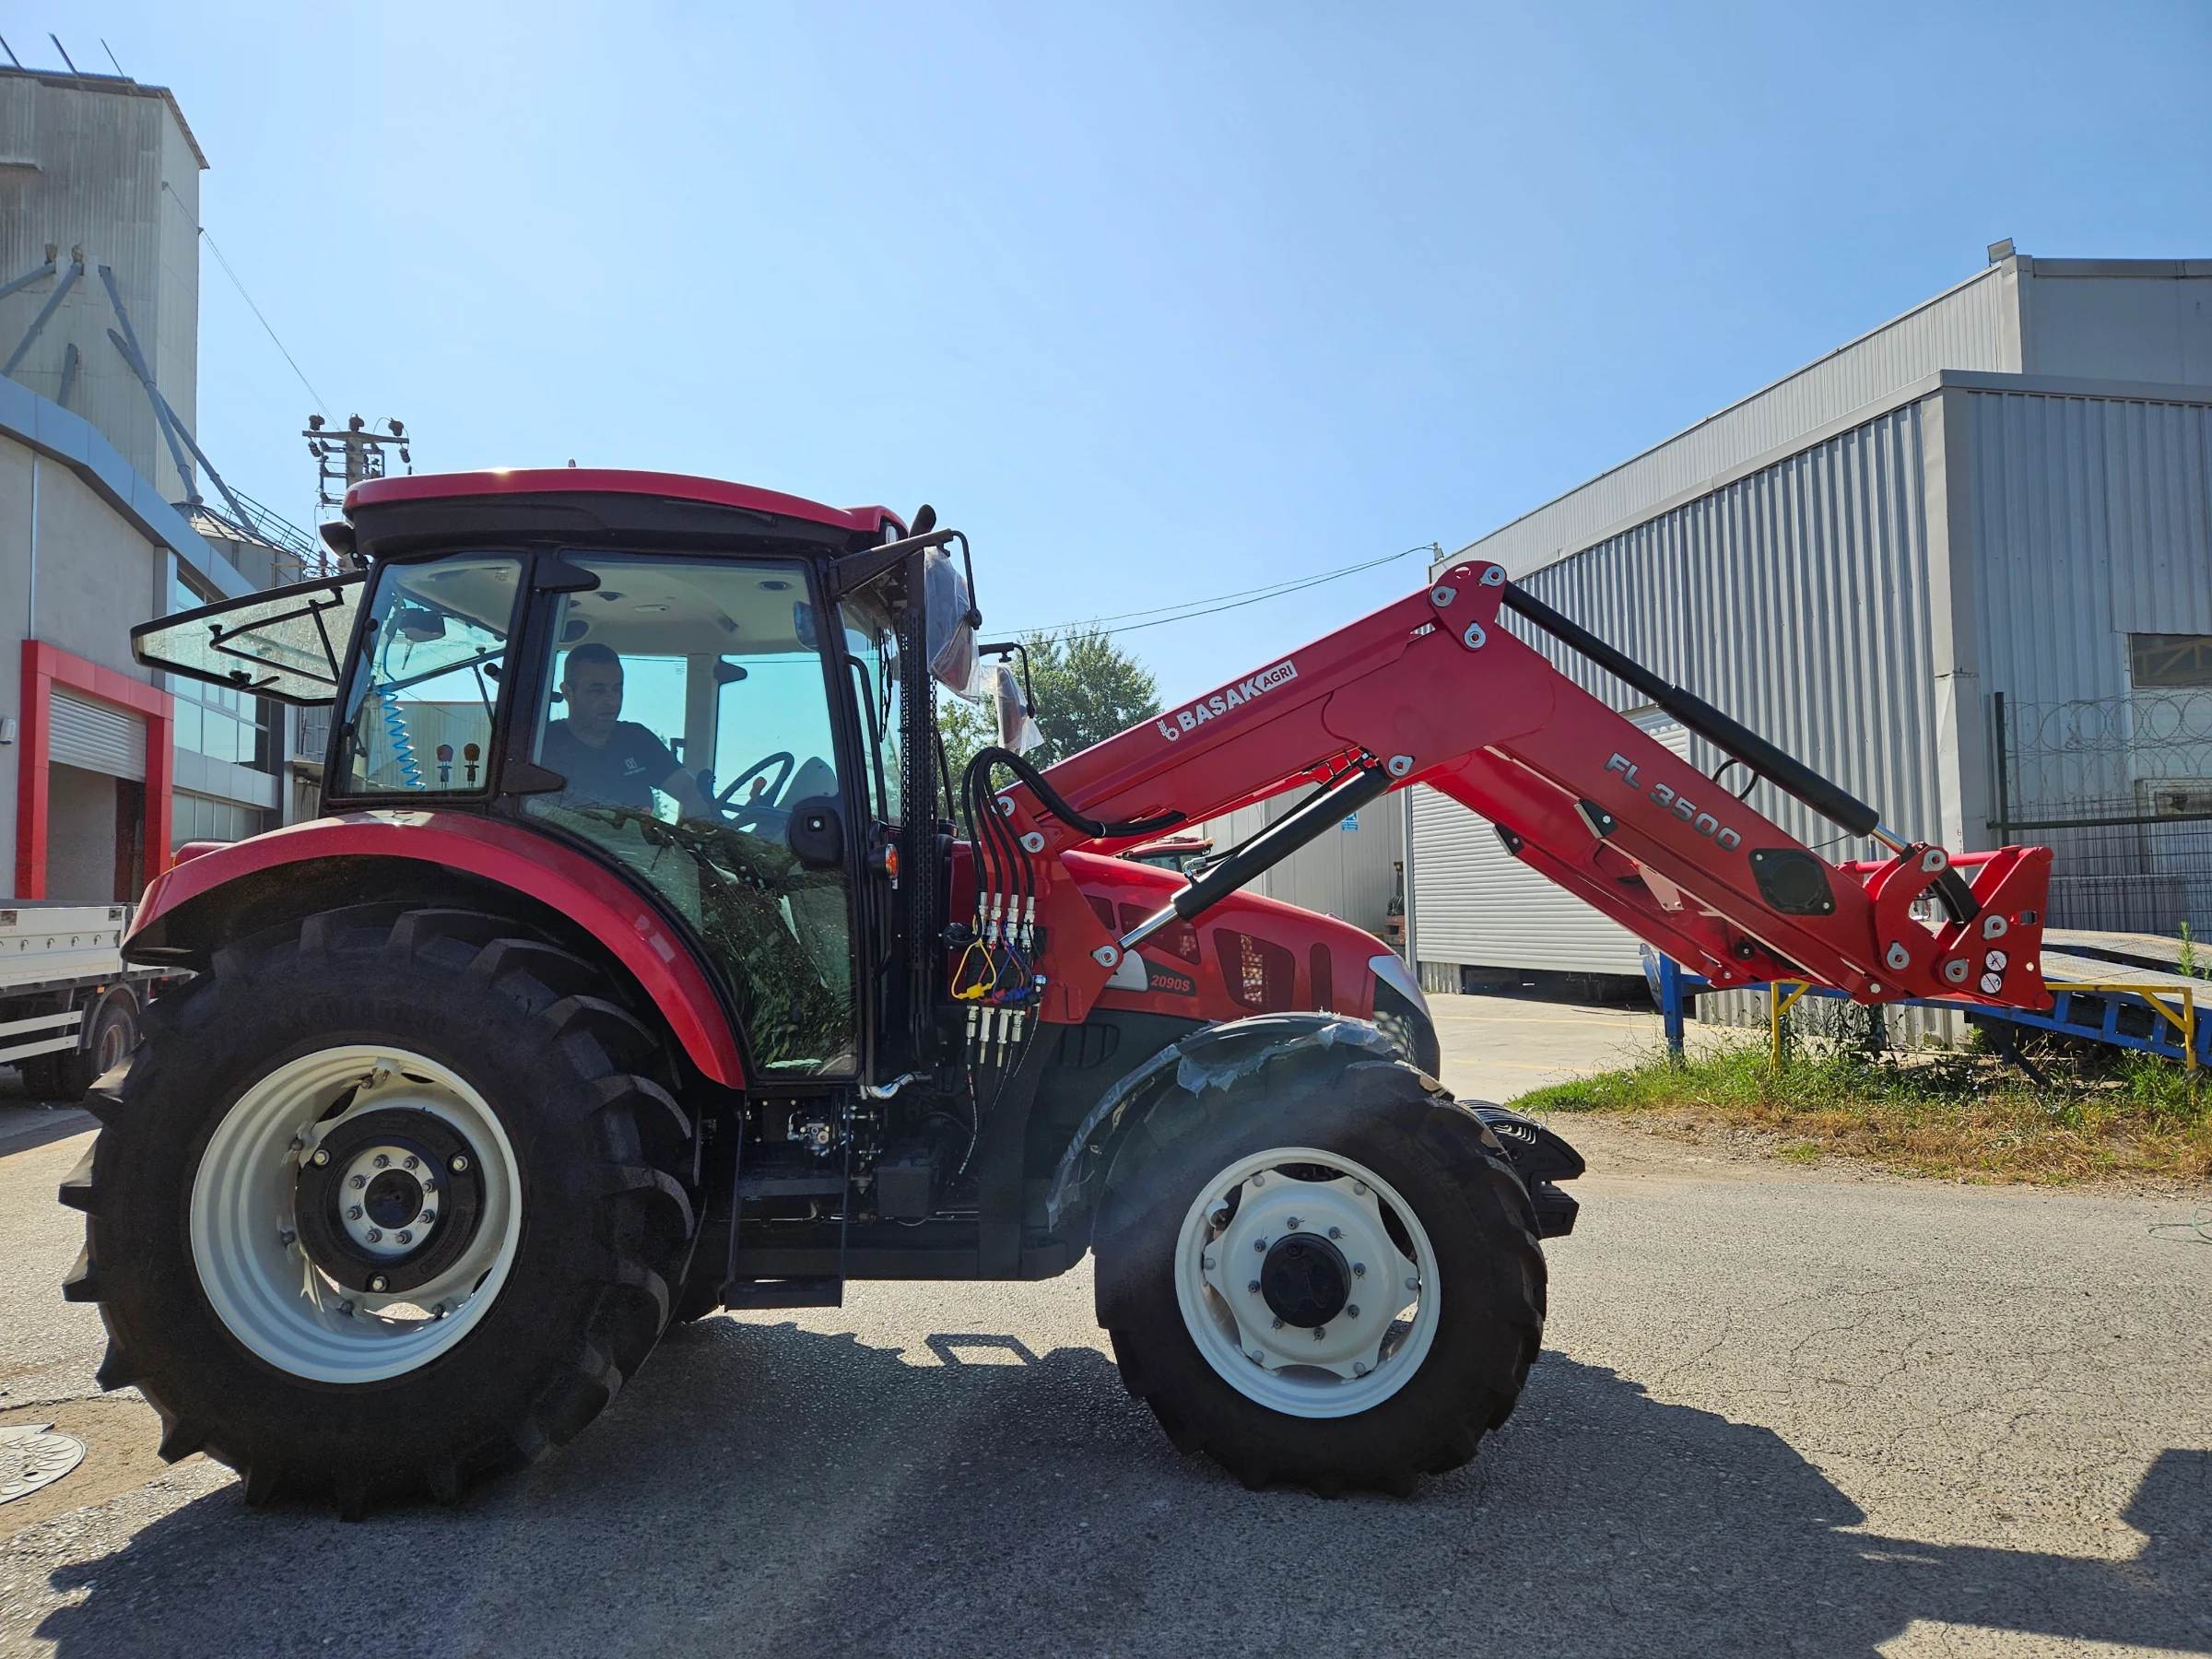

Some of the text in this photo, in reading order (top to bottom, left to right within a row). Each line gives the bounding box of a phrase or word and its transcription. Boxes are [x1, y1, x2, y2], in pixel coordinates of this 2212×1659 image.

[1176, 665, 1293, 733] BASAK AGRI
[1604, 752, 1742, 852] FL 3500
[1150, 974, 1190, 992] 2090S
